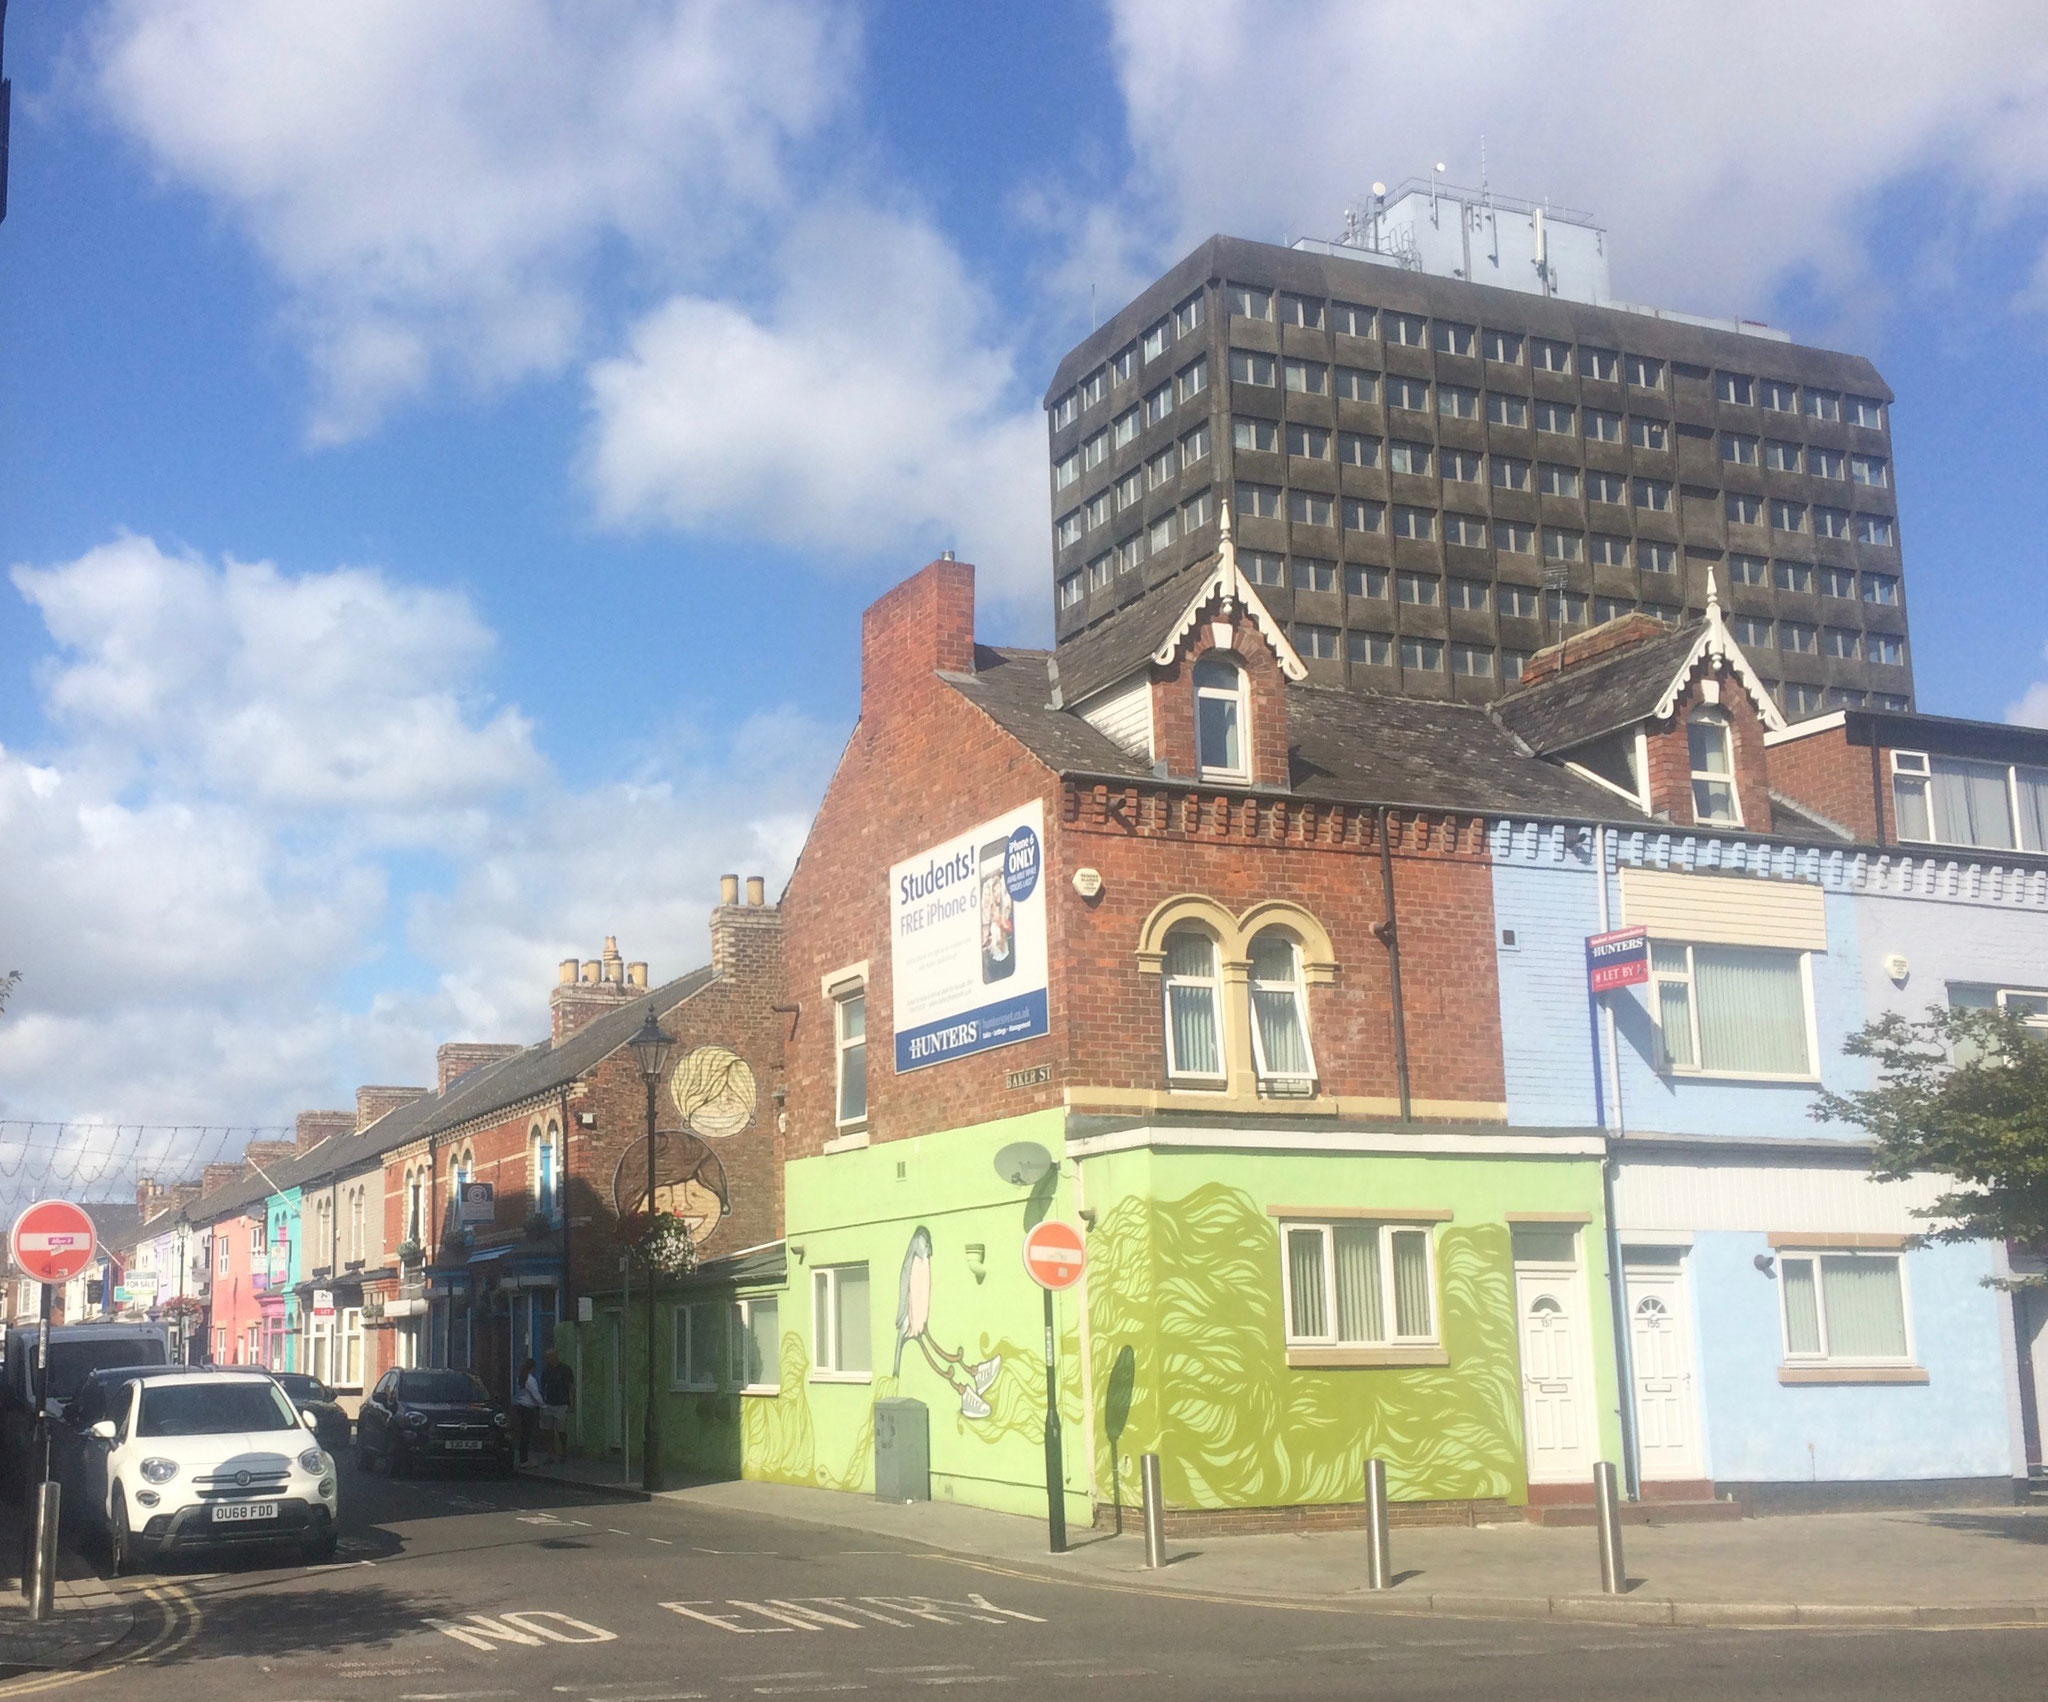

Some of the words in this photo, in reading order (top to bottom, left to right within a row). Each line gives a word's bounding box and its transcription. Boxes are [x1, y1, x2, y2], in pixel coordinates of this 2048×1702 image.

[1008, 837, 1029, 854] iPhone
[1029, 833, 1035, 846] 6
[1009, 845, 1035, 873] ONLY
[901, 845, 975, 905] Students!
[901, 908, 924, 936] FREE
[927, 895, 967, 926] iPhone
[970, 886, 977, 908] 6
[1592, 937, 1644, 957] HUNTERS
[1603, 968, 1619, 981] LET
[1622, 965, 1634, 978] BY
[909, 1020, 979, 1059] HUNTERS
[1006, 1070, 1037, 1089] BAKER
[1039, 1066, 1051, 1082] ST
[126, 1280, 139, 1288] FOR
[140, 1280, 155, 1288] SALE
[216, 1506, 248, 1519] OU68
[250, 1505, 273, 1517] FDD
[420, 1610, 619, 1651] NO
[658, 1593, 1049, 1634] ENTRY
